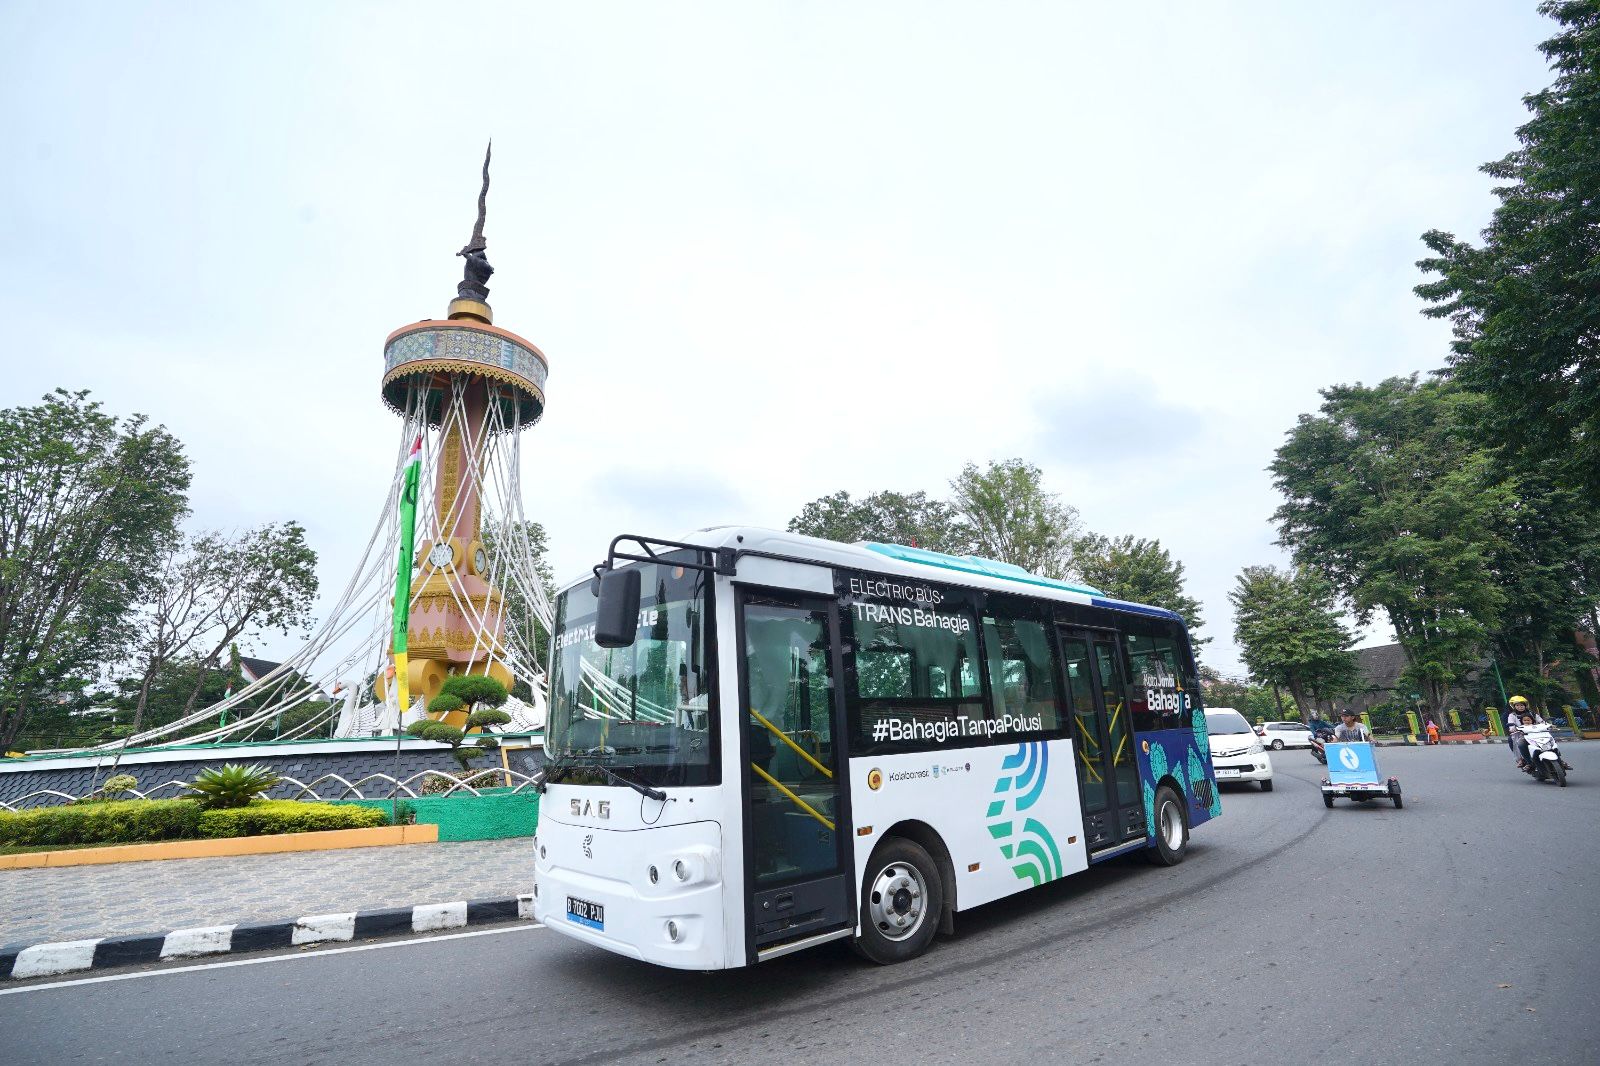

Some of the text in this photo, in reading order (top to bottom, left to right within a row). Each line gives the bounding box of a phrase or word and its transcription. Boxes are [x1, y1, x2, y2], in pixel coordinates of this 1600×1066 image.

[850, 578, 941, 604] ELECTRIC BUS
[872, 713, 1043, 742] #BahagiaTanpaPolusi
[568, 898, 572, 912] B
[573, 901, 587, 918] 7002
